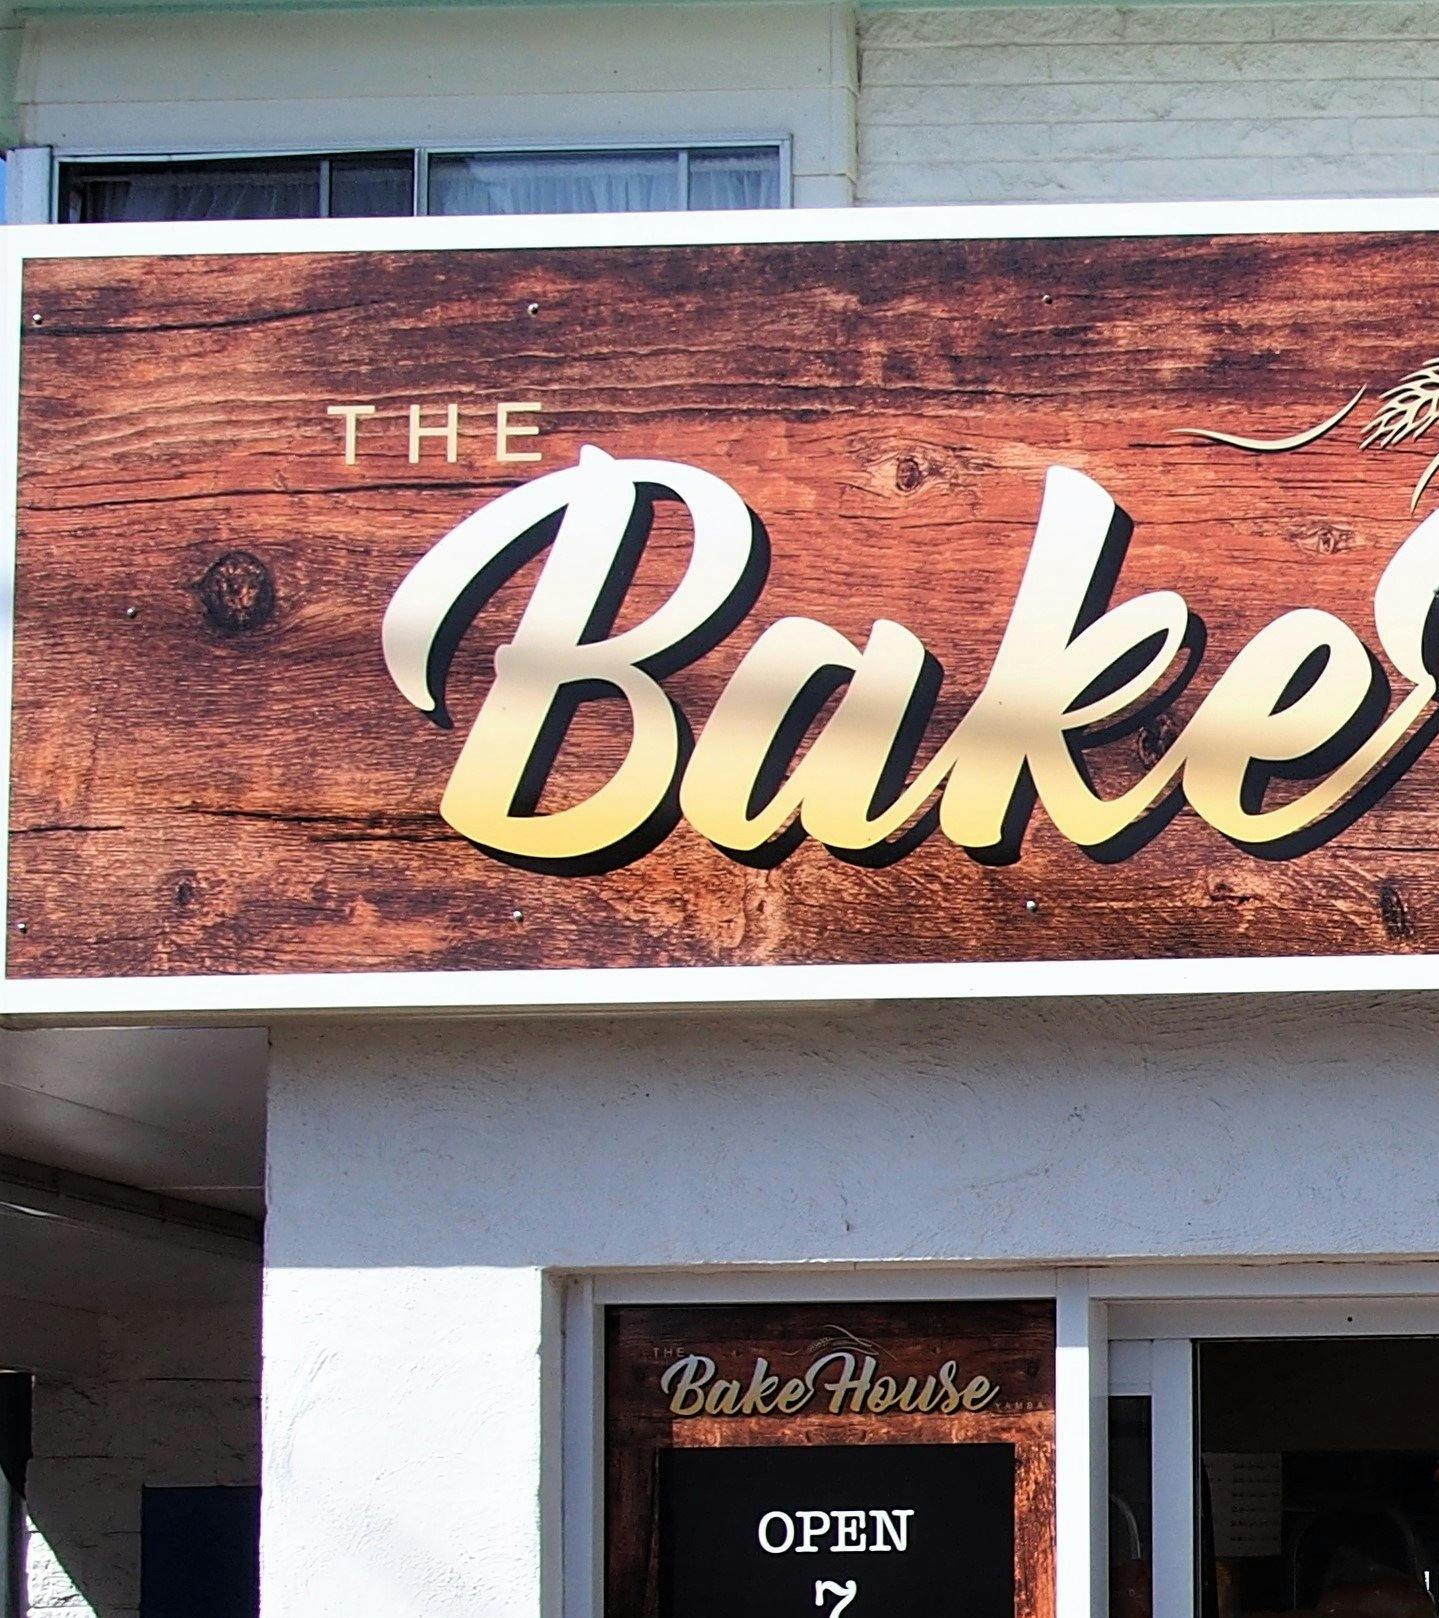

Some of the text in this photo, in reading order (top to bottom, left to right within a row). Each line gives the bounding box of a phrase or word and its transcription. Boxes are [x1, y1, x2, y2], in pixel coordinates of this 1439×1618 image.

[328, 402, 543, 464] THE
[652, 1347, 685, 1359] THE
[758, 1509, 915, 1554] OPEN
